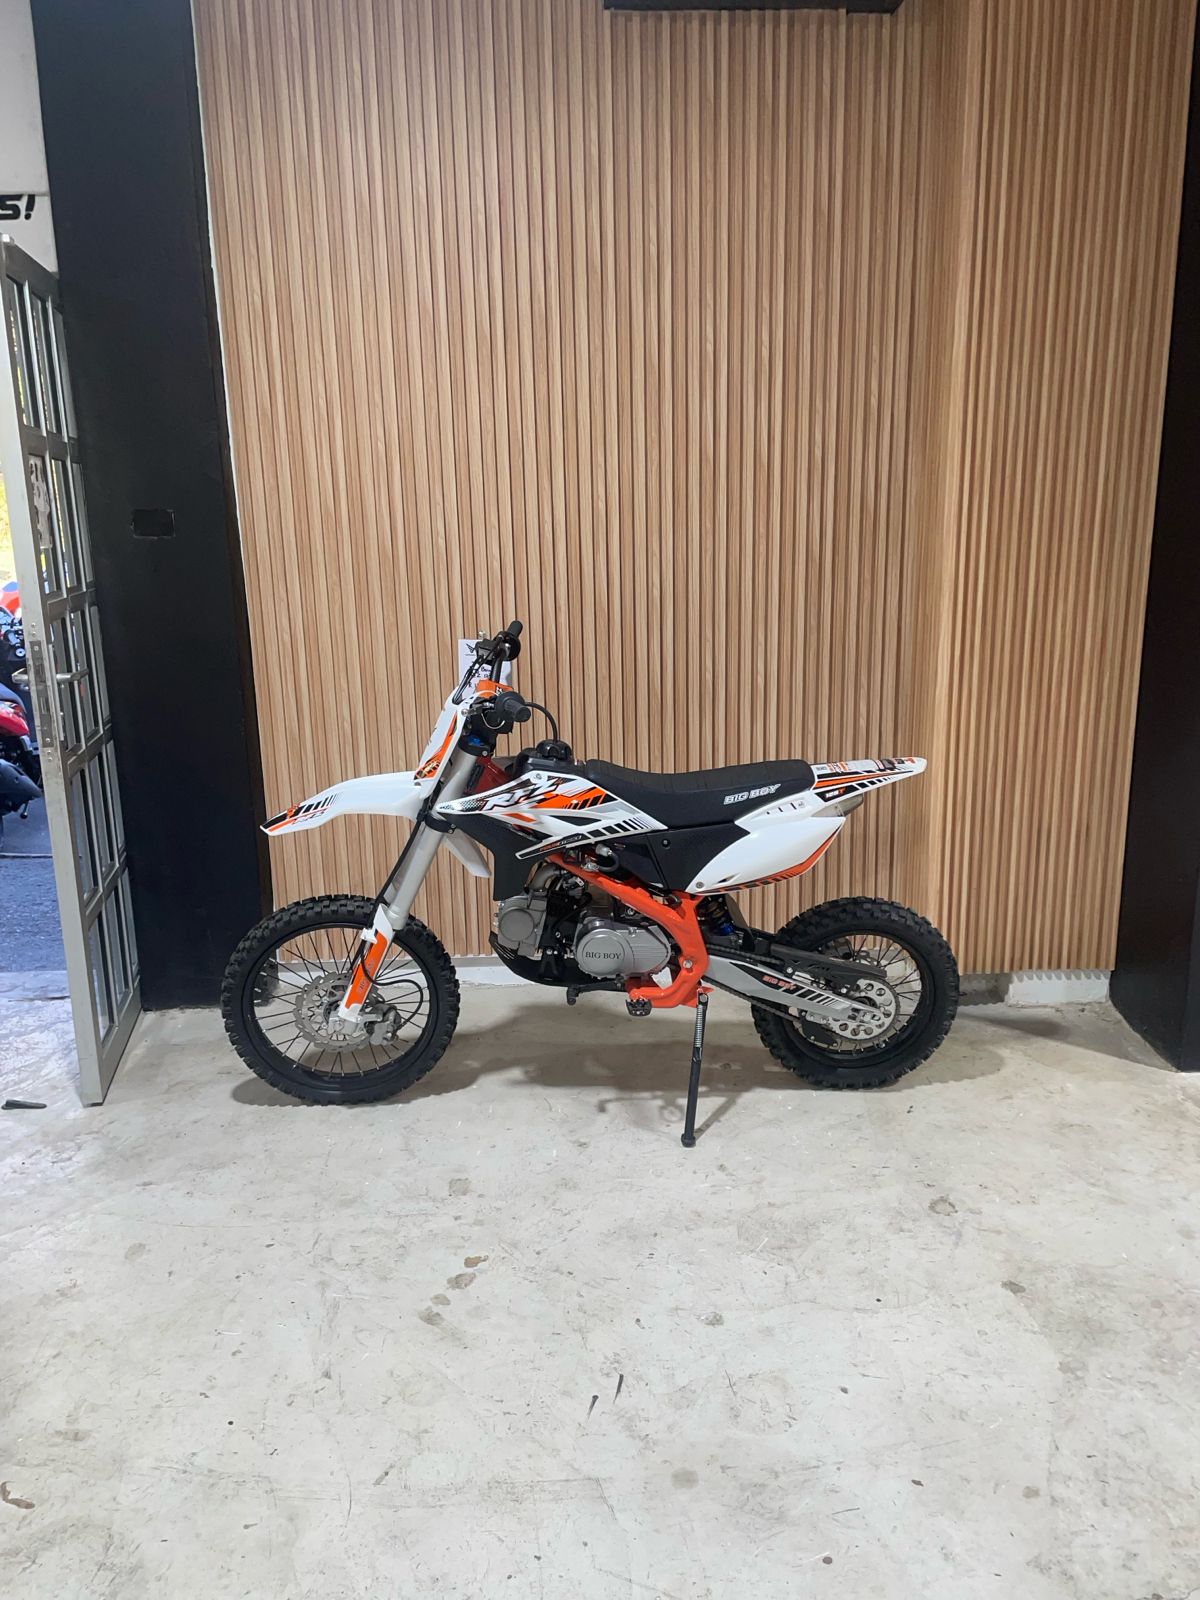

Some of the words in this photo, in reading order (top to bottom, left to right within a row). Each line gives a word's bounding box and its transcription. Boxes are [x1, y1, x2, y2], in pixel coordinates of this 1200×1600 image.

[723, 791, 749, 805] BIG
[749, 783, 781, 799] BOY
[585, 951, 601, 959] BIG
[603, 952, 621, 960] BOY
